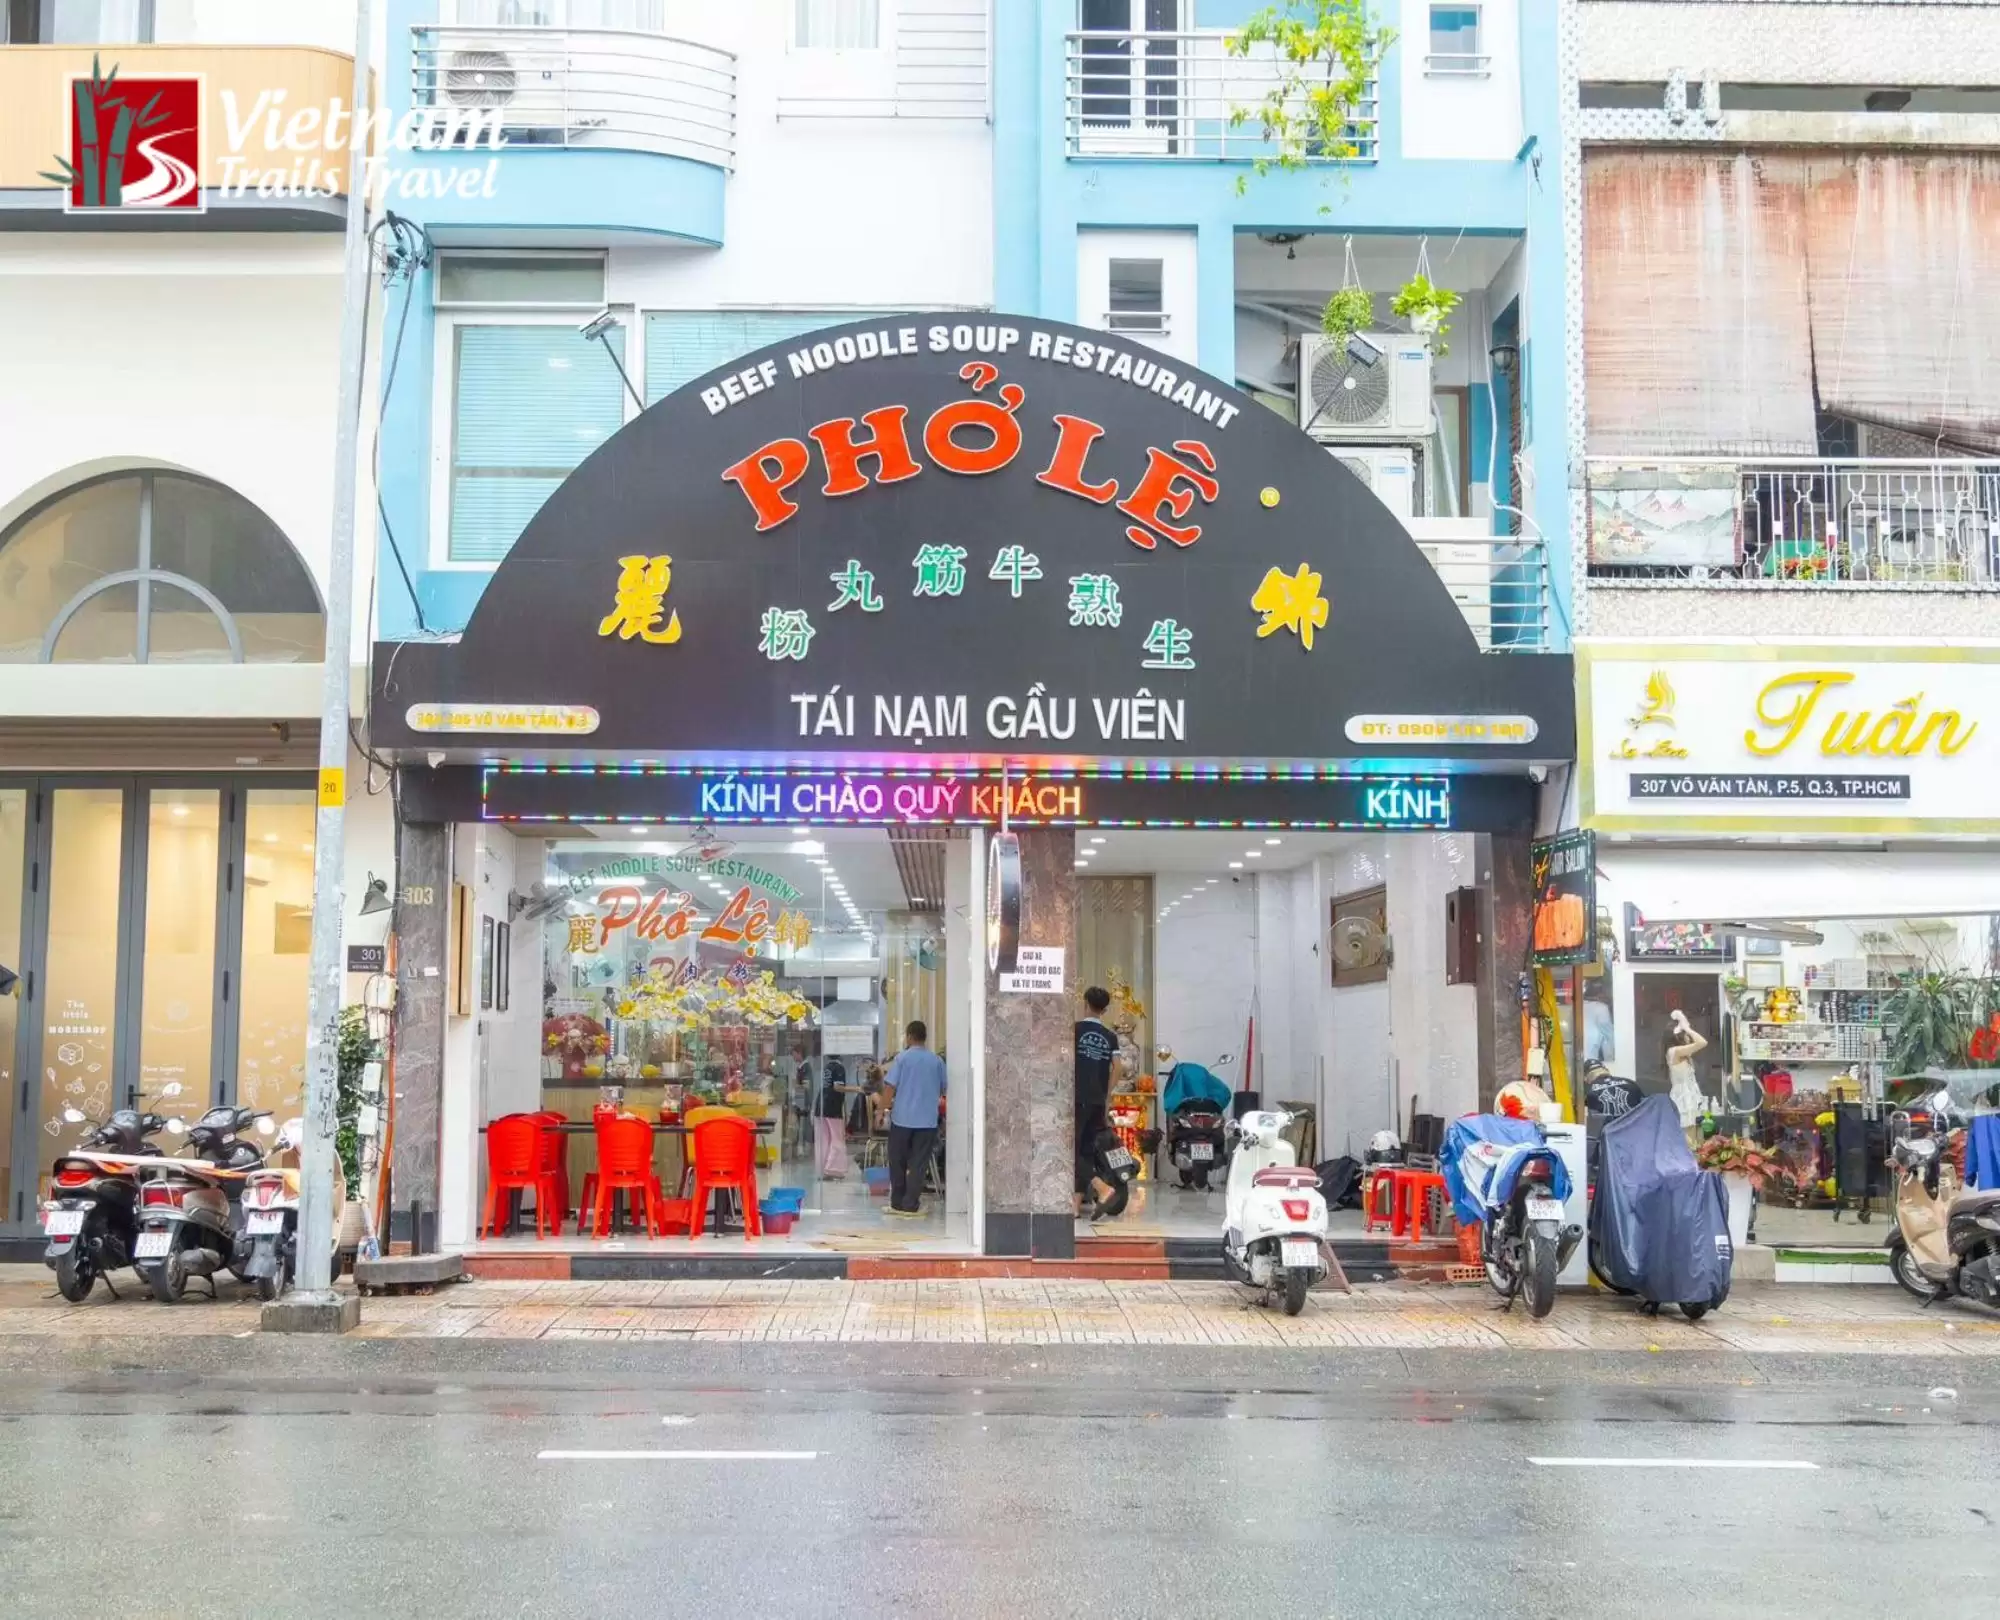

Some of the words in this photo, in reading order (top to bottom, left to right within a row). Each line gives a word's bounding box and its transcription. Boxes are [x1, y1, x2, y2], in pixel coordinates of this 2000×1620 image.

[700, 359, 778, 416] BEEF
[787, 327, 919, 379] NOODLE
[928, 325, 1019, 352] SOUP
[1029, 331, 1240, 430] RESTAURANT
[721, 360, 1026, 532] PHỞ
[1035, 414, 1220, 550] LỆ
[790, 685, 854, 737] TÁI
[874, 695, 968, 746] NẠM
[986, 682, 1077, 741] GẦU
[1092, 687, 1186, 741] VIÊN
[1743, 671, 1979, 757] Tuấn
[702, 775, 781, 812] KÍNH
[792, 776, 884, 813] CHÀO
[893, 778, 961, 819] QUÝ
[971, 777, 1081, 816] KHÁCH
[1366, 780, 1447, 819] KÍNH
[1640, 779, 1668, 794] 307
[1670, 776, 1695, 794] VÕ
[1697, 776, 1732, 794] VĂN
[1777, 781, 1804, 797] P.5,
[1807, 781, 1838, 797] Q.3,
[1841, 781, 1902, 795] TP.HCM
[600, 856, 660, 879] NOODLE
[706, 857, 804, 904] RESTAURANT
[597, 884, 700, 946] Phở
[701, 884, 769, 957] Lệ
[361, 948, 382, 961] 301
